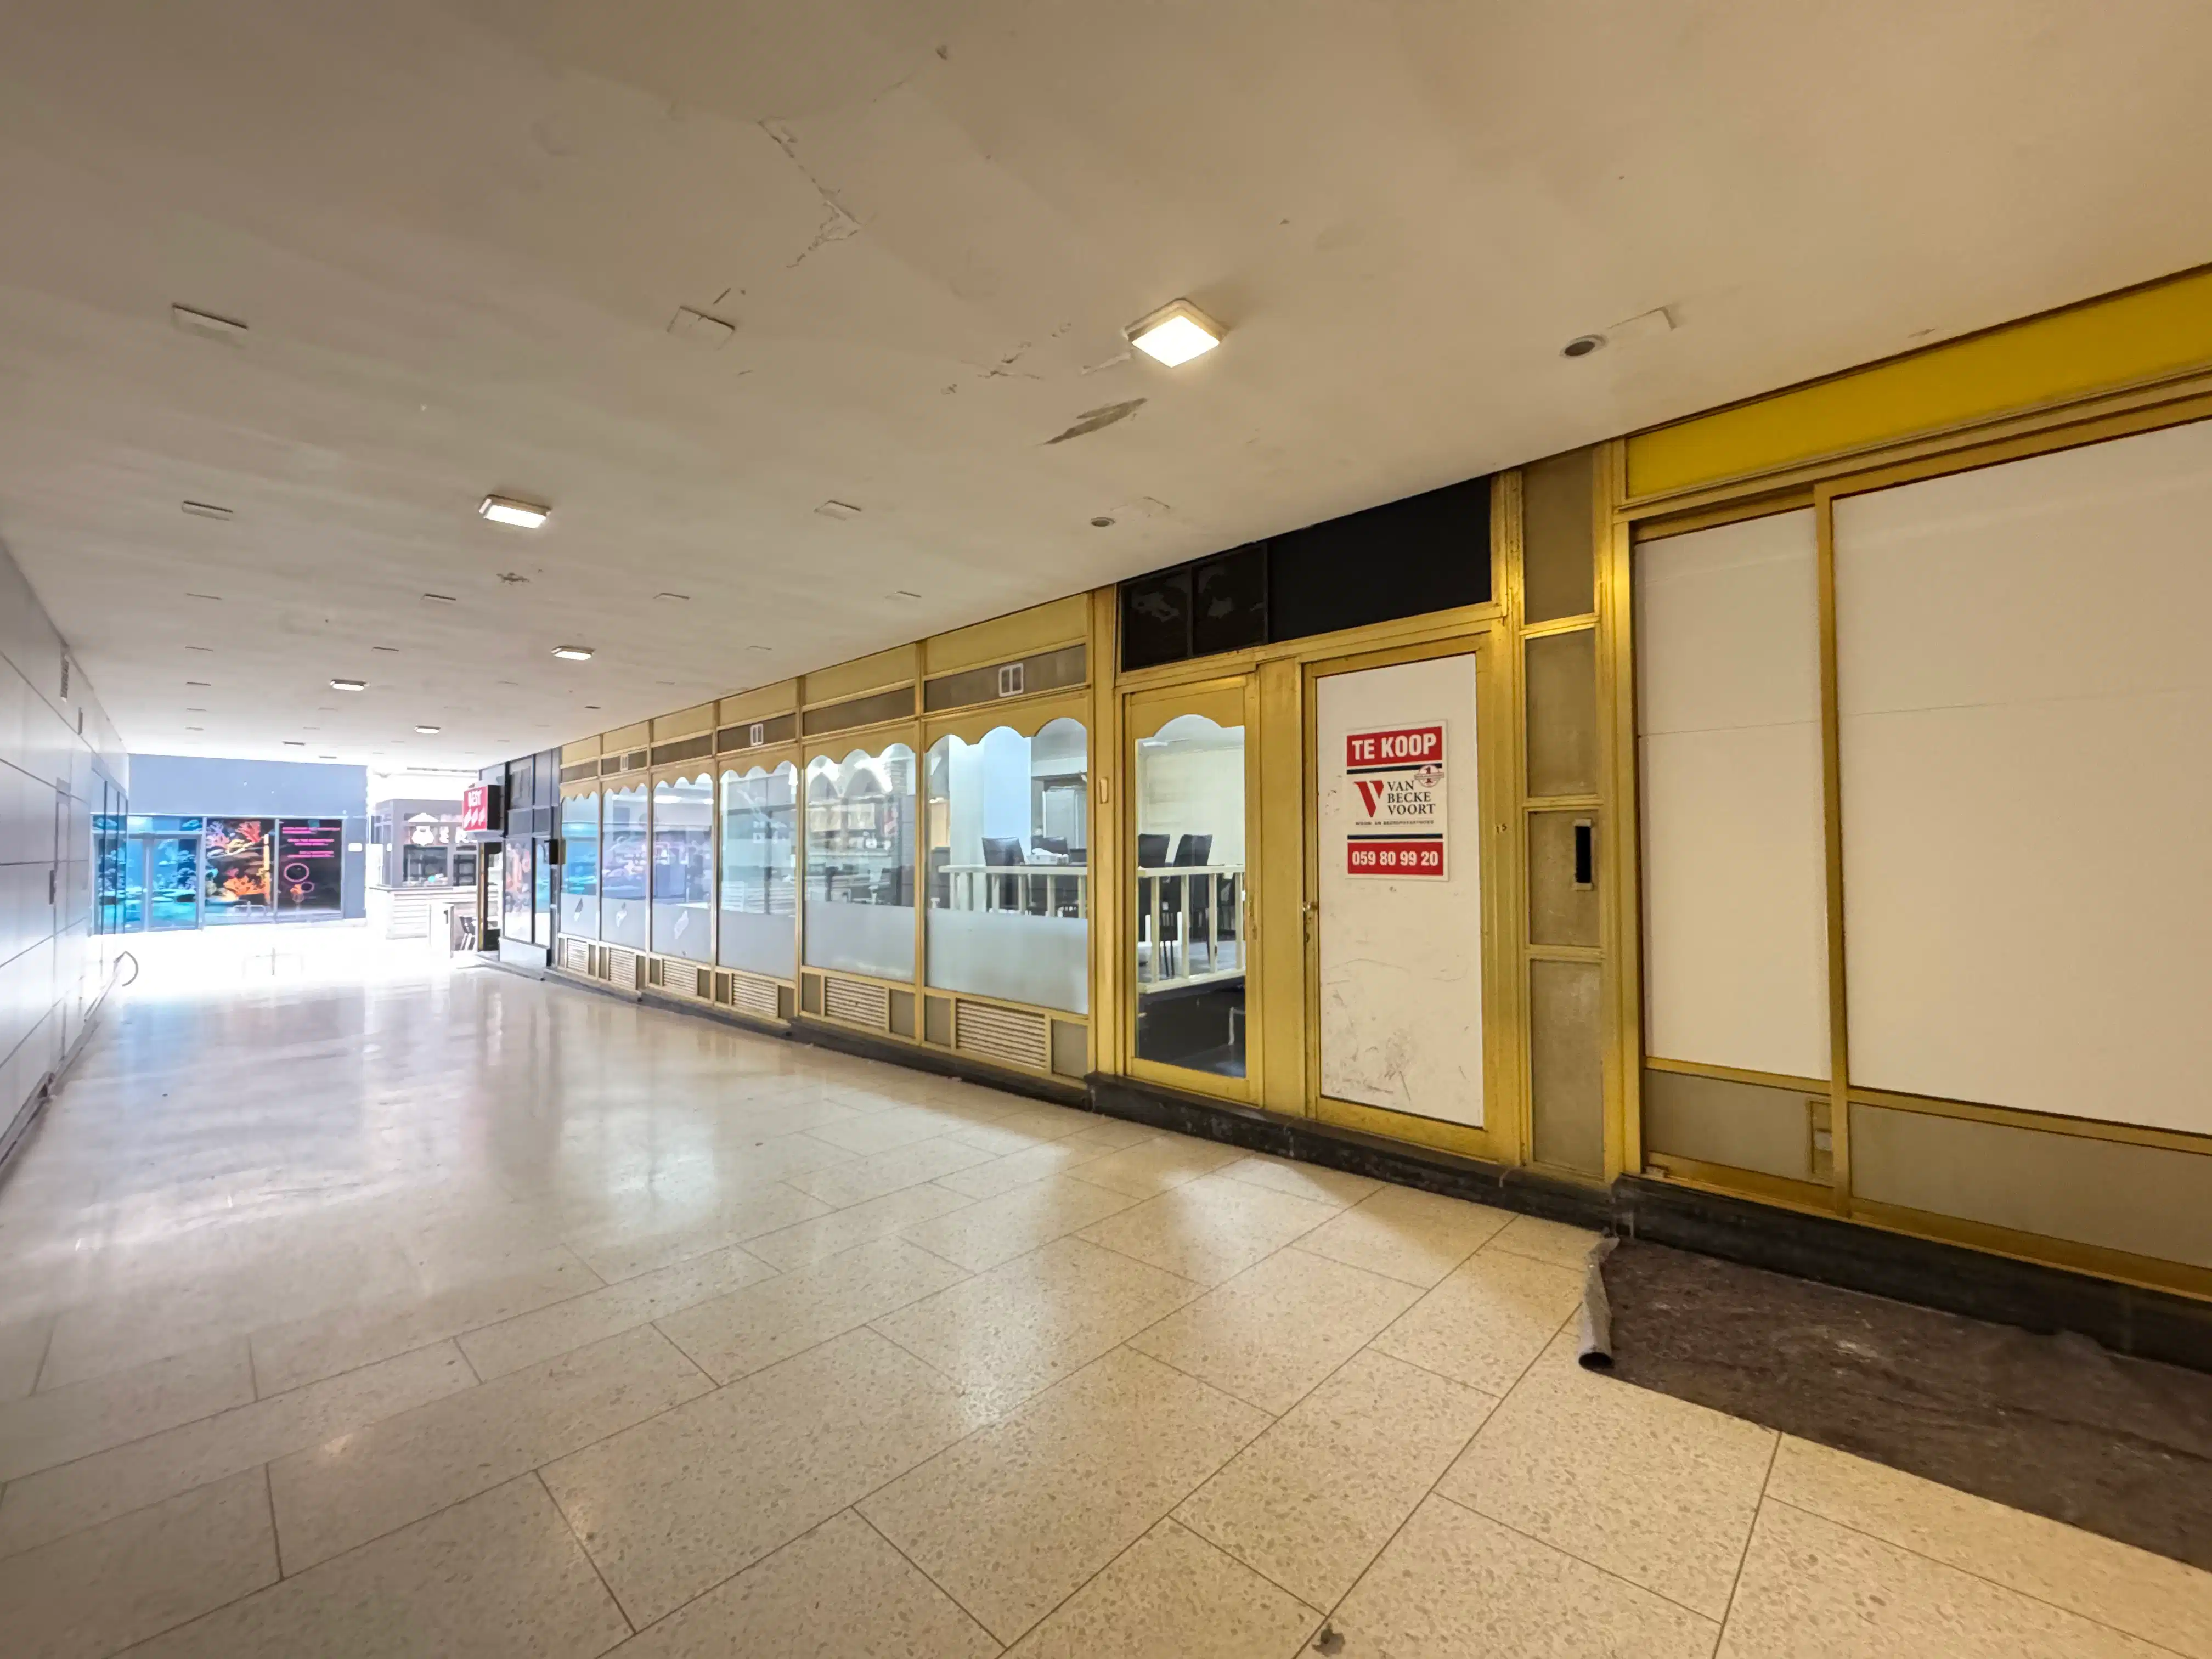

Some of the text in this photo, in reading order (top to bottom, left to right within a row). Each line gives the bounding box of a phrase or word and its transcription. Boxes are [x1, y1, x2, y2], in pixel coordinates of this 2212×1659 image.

[1352, 733, 1436, 760] TE KOOP
[1387, 780, 1414, 791] VAN
[1387, 792, 1431, 804] BECKE
[1387, 803, 1436, 815] VOORT
[1352, 851, 1438, 866] 059 80 99 20
